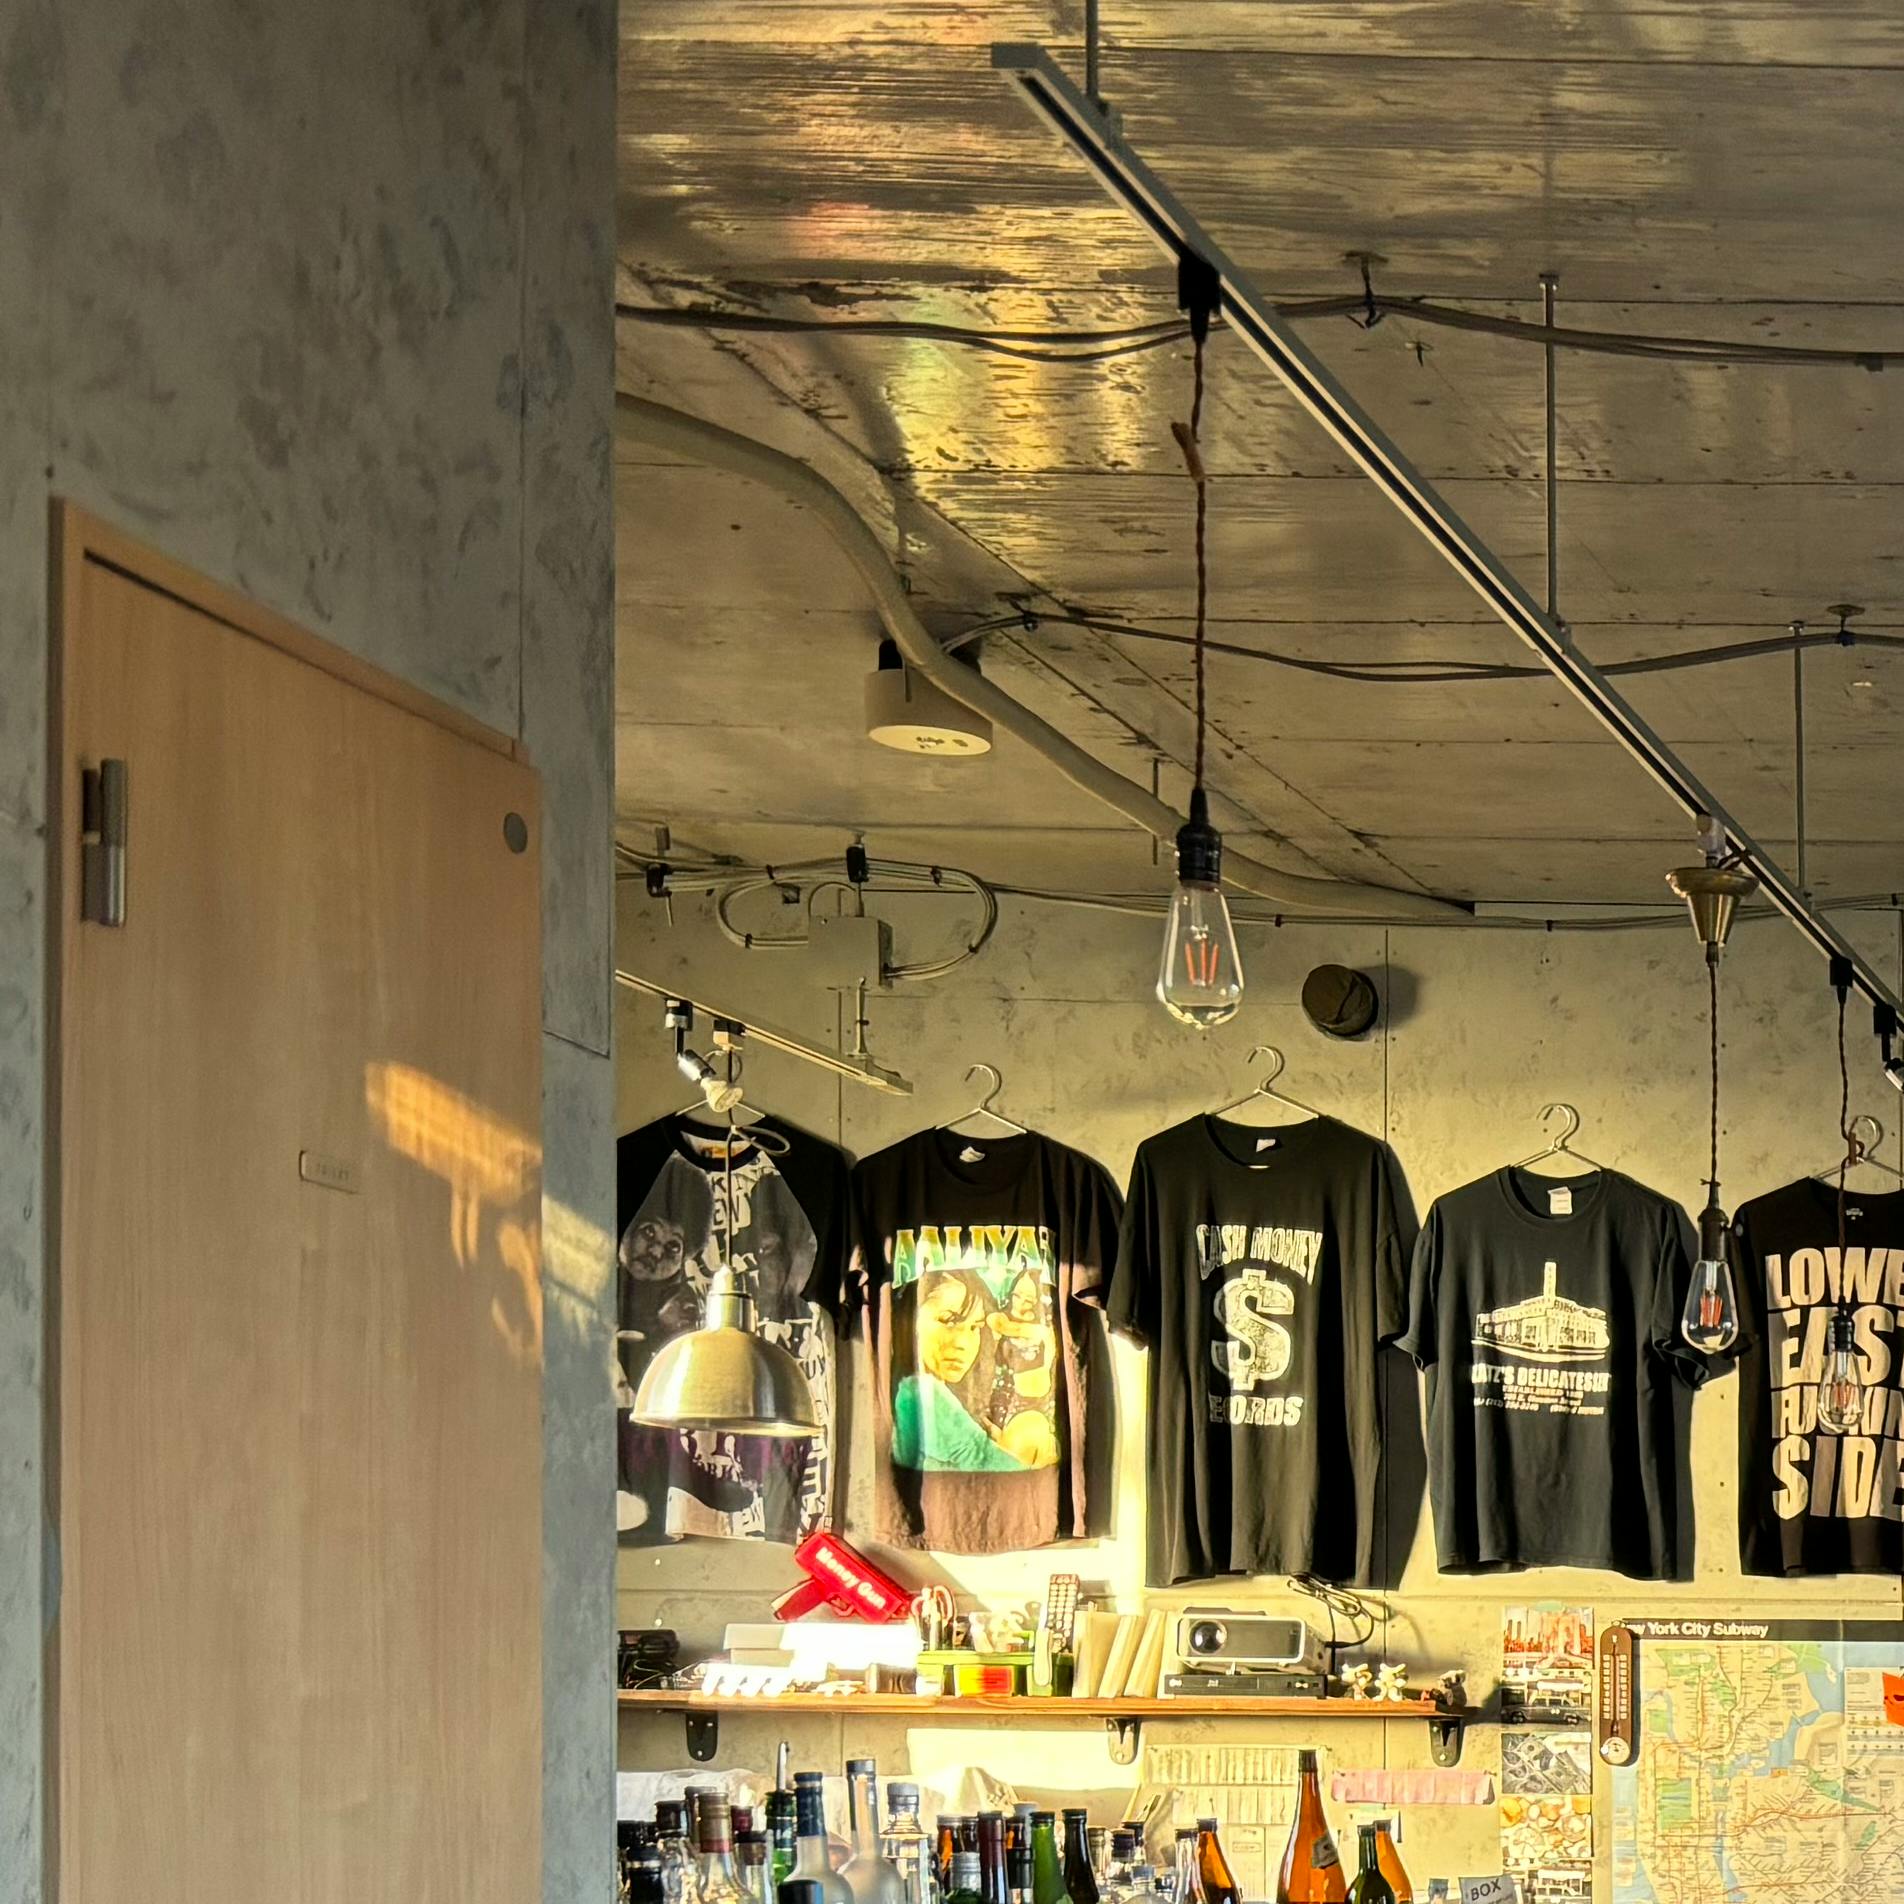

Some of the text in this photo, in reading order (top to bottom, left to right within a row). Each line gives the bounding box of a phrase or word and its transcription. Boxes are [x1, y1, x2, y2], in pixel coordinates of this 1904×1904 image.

[1250, 1226, 1323, 1286] MONEY
[816, 1546, 887, 1610] Money Gun
[1647, 1621, 1680, 1635] York
[1681, 1621, 1712, 1638] City
[1713, 1621, 1769, 1639] Subway
[1470, 1878, 1502, 1901] BOX
